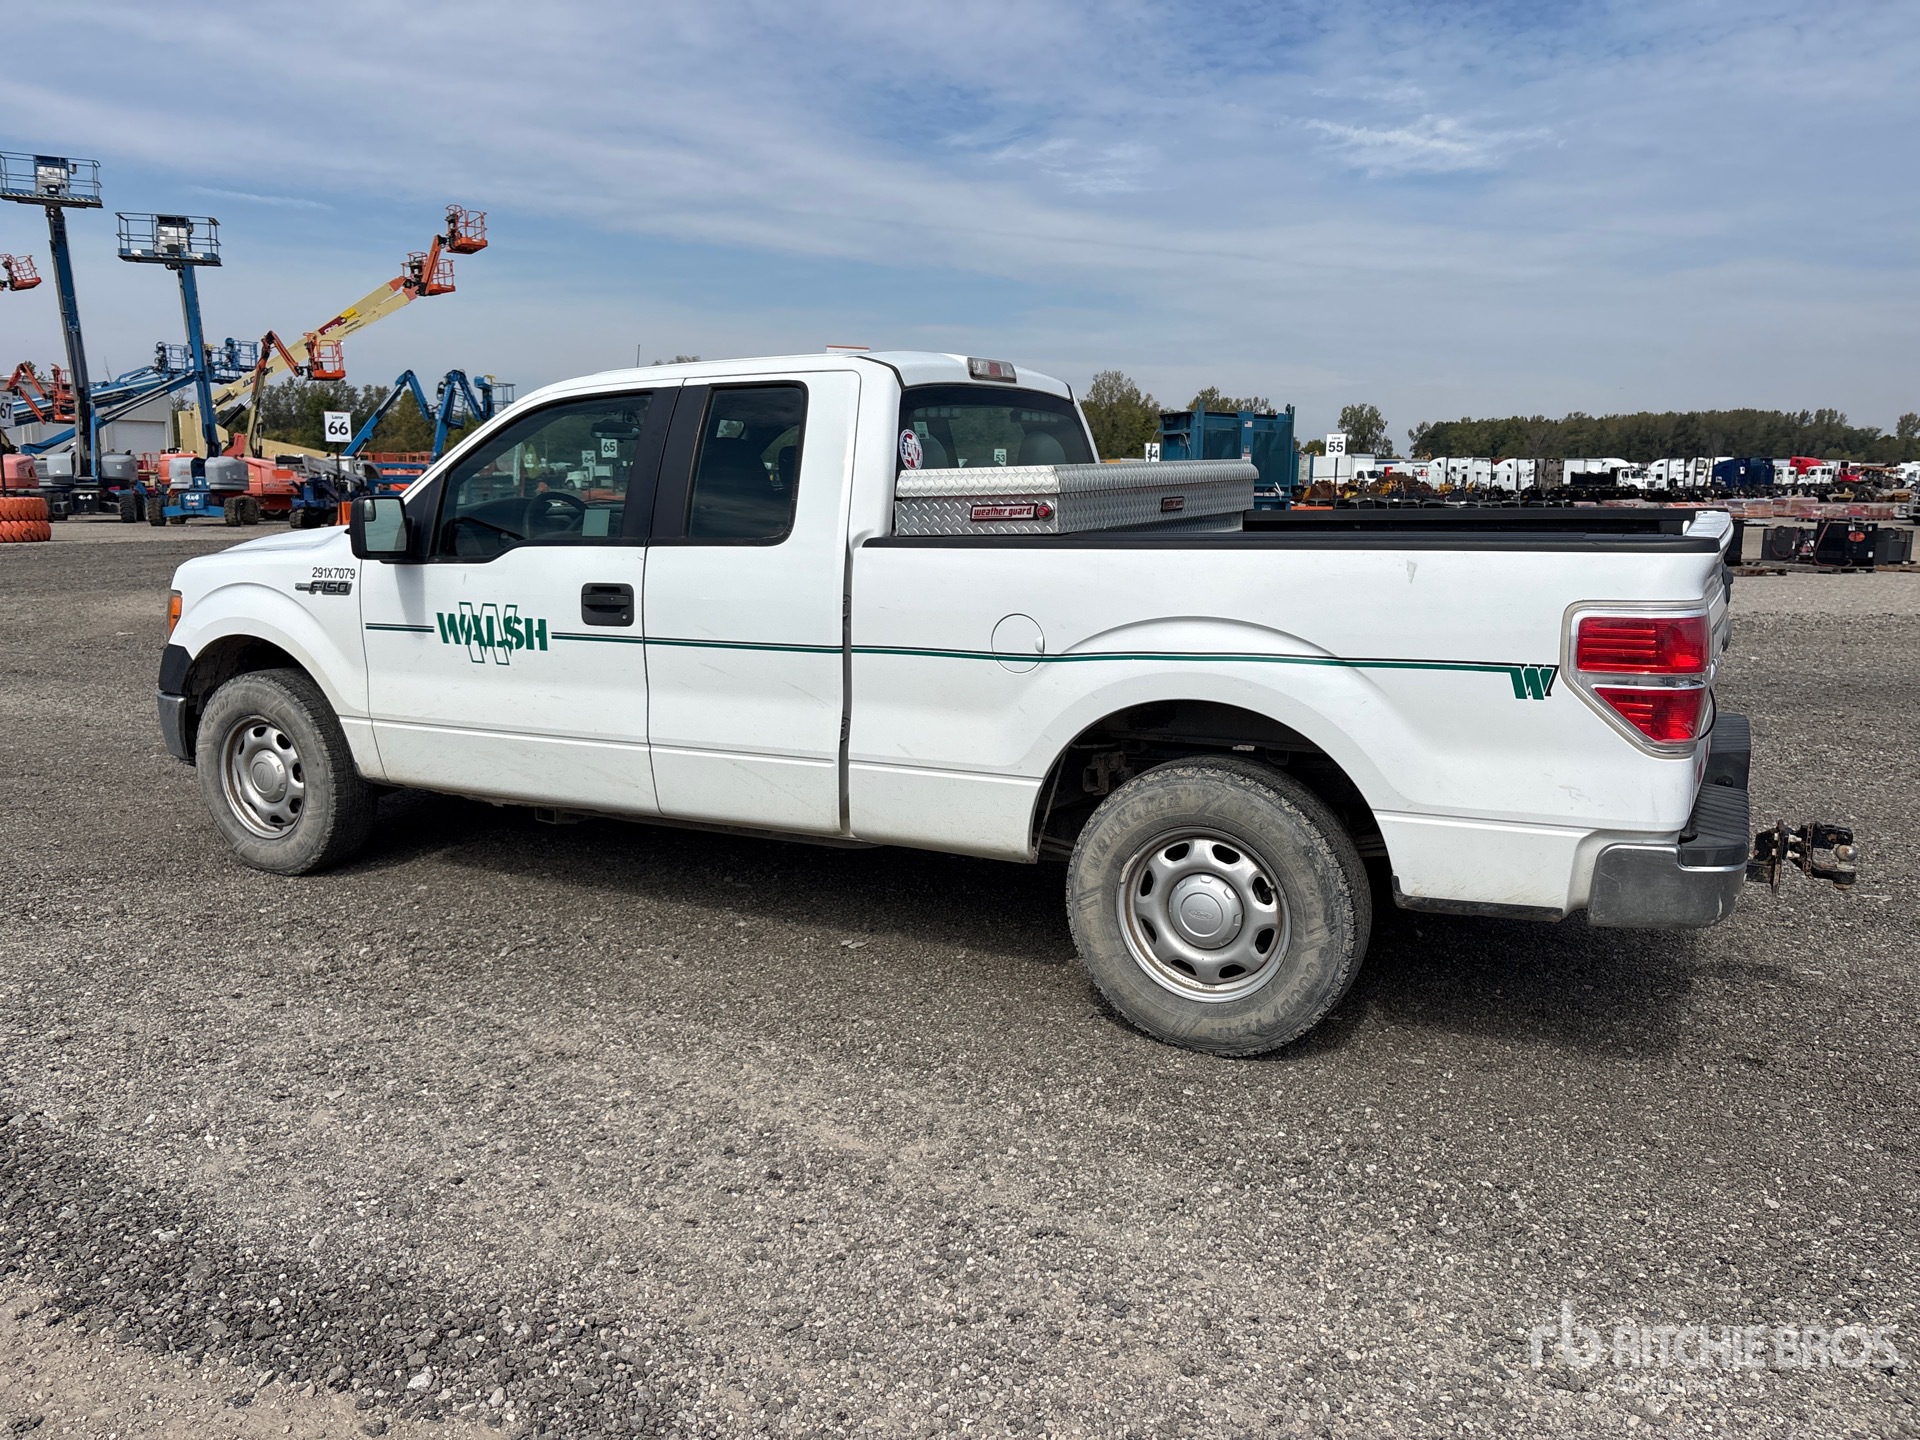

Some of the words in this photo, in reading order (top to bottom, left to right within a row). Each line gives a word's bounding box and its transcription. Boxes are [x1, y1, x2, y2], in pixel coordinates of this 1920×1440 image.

[0, 402, 12, 419] 67
[328, 421, 349, 436] 66
[603, 442, 616, 453] 65
[1328, 441, 1344, 453] 55
[584, 456, 595, 464] 64
[996, 454, 1006, 463] 53
[974, 507, 1008, 516] weather
[1008, 506, 1032, 517] guard
[312, 566, 356, 580] 291X7079
[436, 612, 548, 652] WALSH
